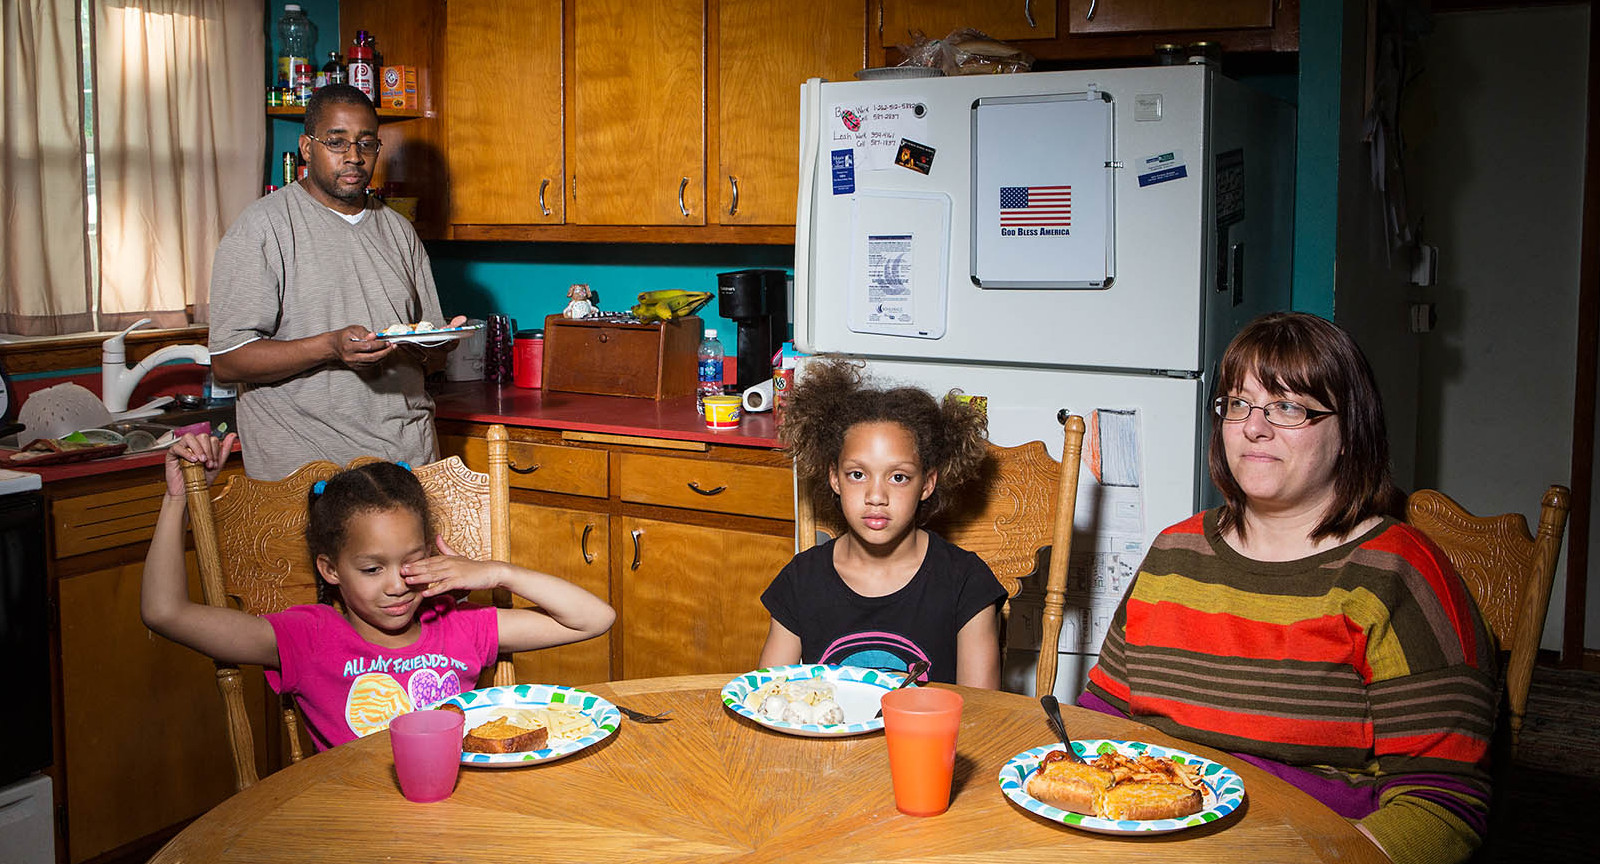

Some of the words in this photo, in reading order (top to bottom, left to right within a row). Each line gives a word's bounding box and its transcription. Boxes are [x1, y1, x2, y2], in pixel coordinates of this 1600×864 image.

[833, 130, 852, 140] Leah
[775, 377, 785, 388] V8
[343, 656, 365, 677] ALL
[367, 654, 392, 673] MY
[393, 653, 448, 673] FRIENDS
